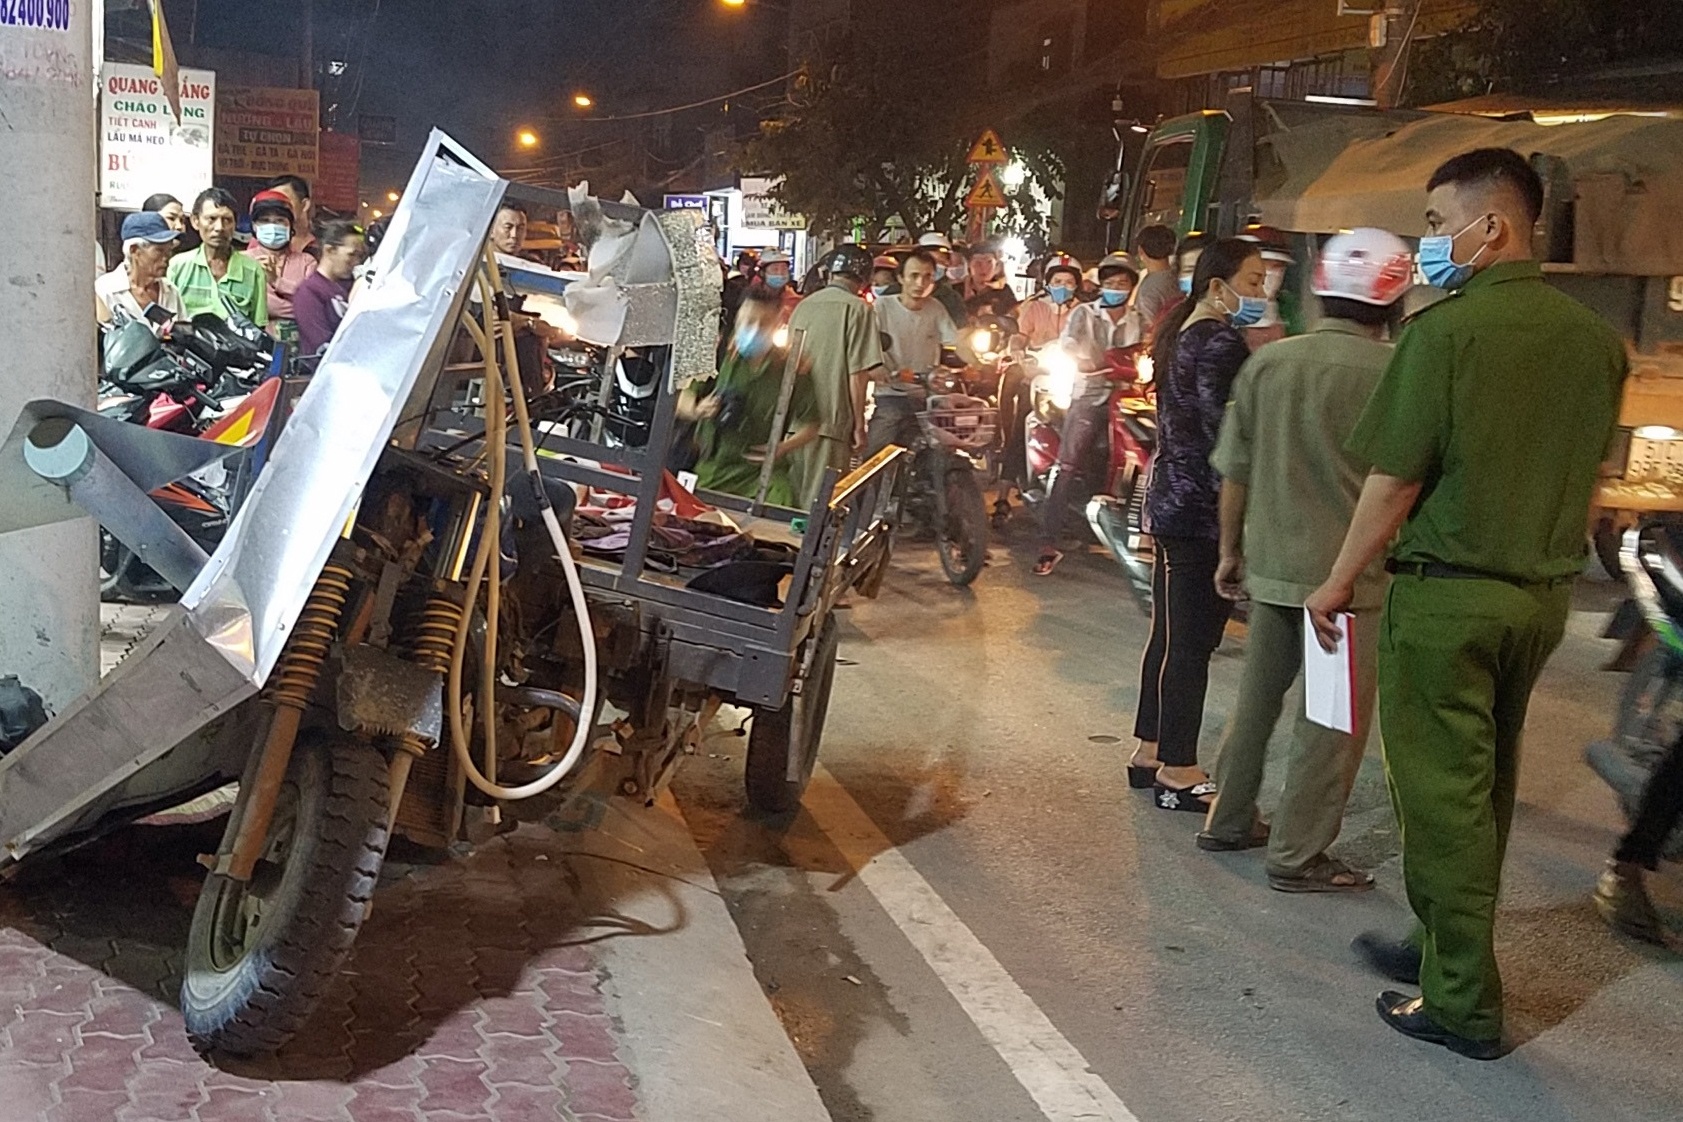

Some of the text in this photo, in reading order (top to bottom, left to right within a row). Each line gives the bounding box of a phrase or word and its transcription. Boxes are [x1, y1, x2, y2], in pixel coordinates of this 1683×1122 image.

[108, 77, 159, 95] QUANG
[163, 104, 205, 118] LNG
[132, 117, 157, 129] CANH
[146, 135, 165, 145] HEO
